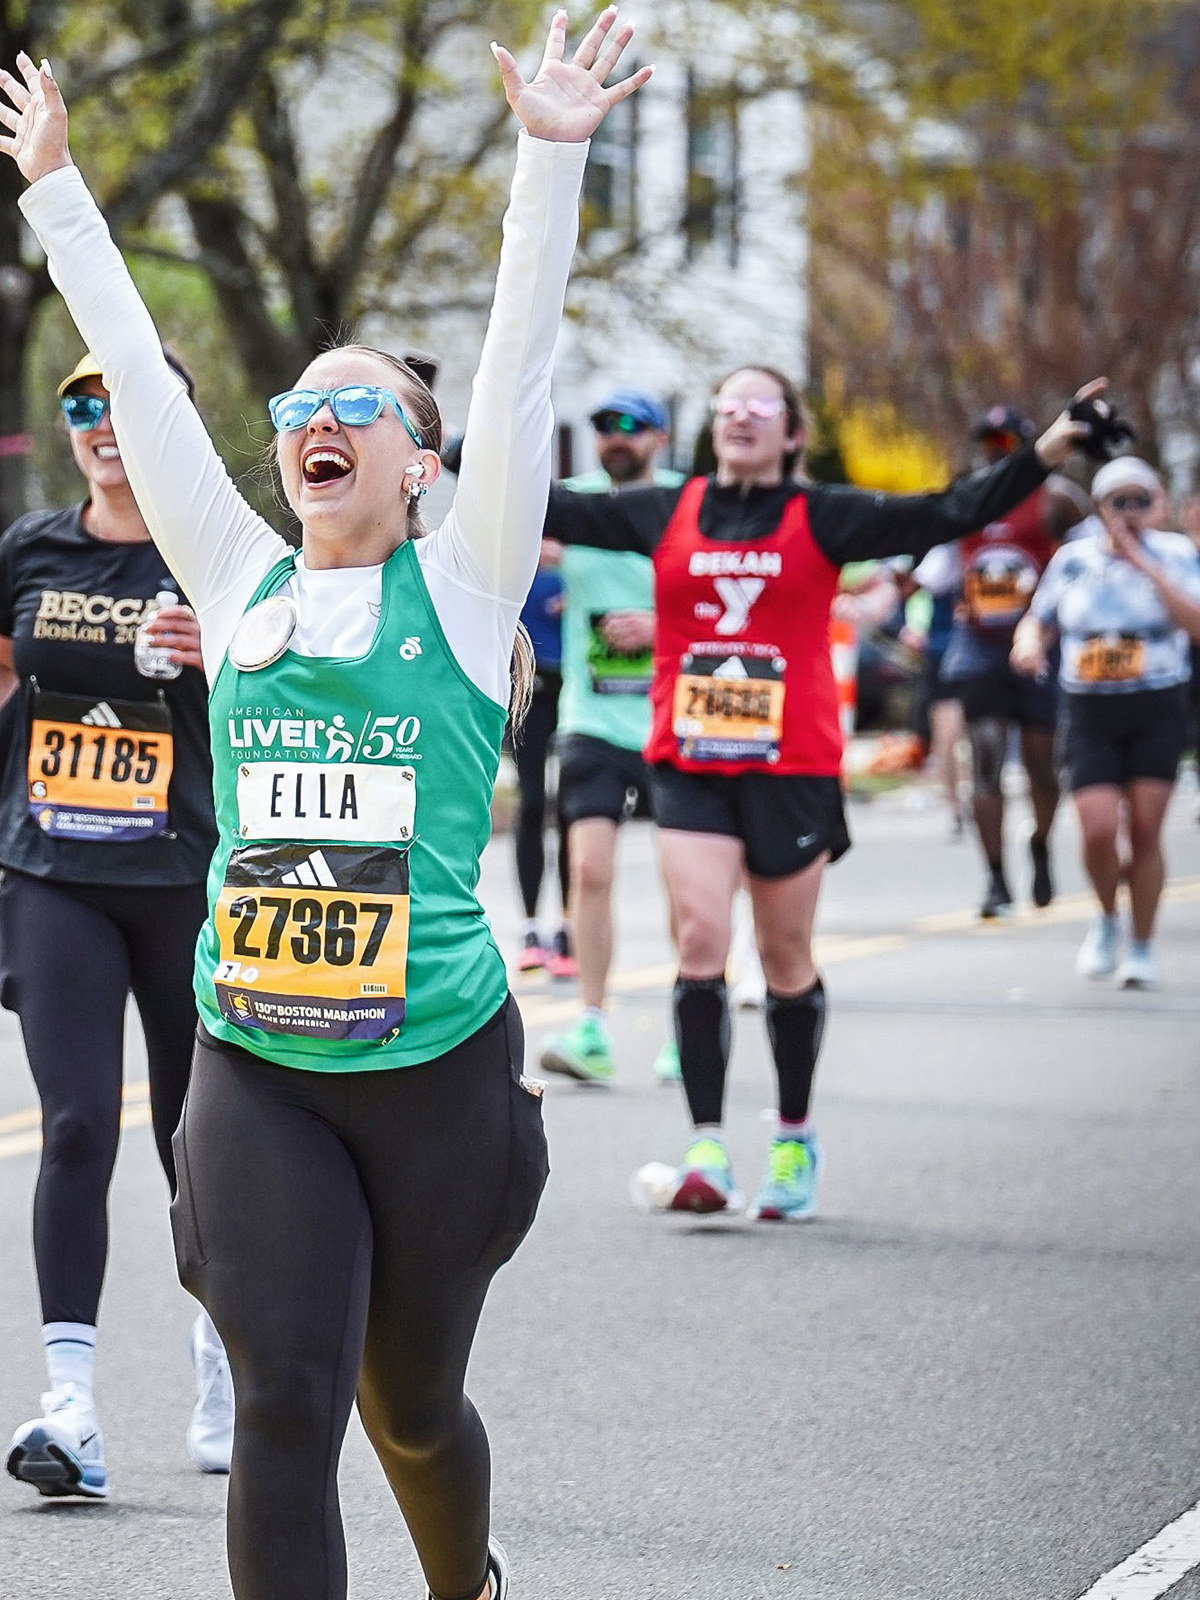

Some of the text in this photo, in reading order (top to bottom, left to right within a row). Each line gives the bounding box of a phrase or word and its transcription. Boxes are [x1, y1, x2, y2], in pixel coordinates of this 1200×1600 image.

[33, 618, 107, 644] Boston
[228, 707, 304, 717] AMERICAN
[41, 729, 158, 784] 31185
[230, 750, 320, 760] FOUNDATION
[270, 773, 358, 820] ELLA
[229, 895, 394, 967] 27367
[257, 1013, 331, 1029] BANK OF AMERICA
[277, 1005, 322, 1019] BOSTON
[323, 1008, 386, 1022] MARATHON
